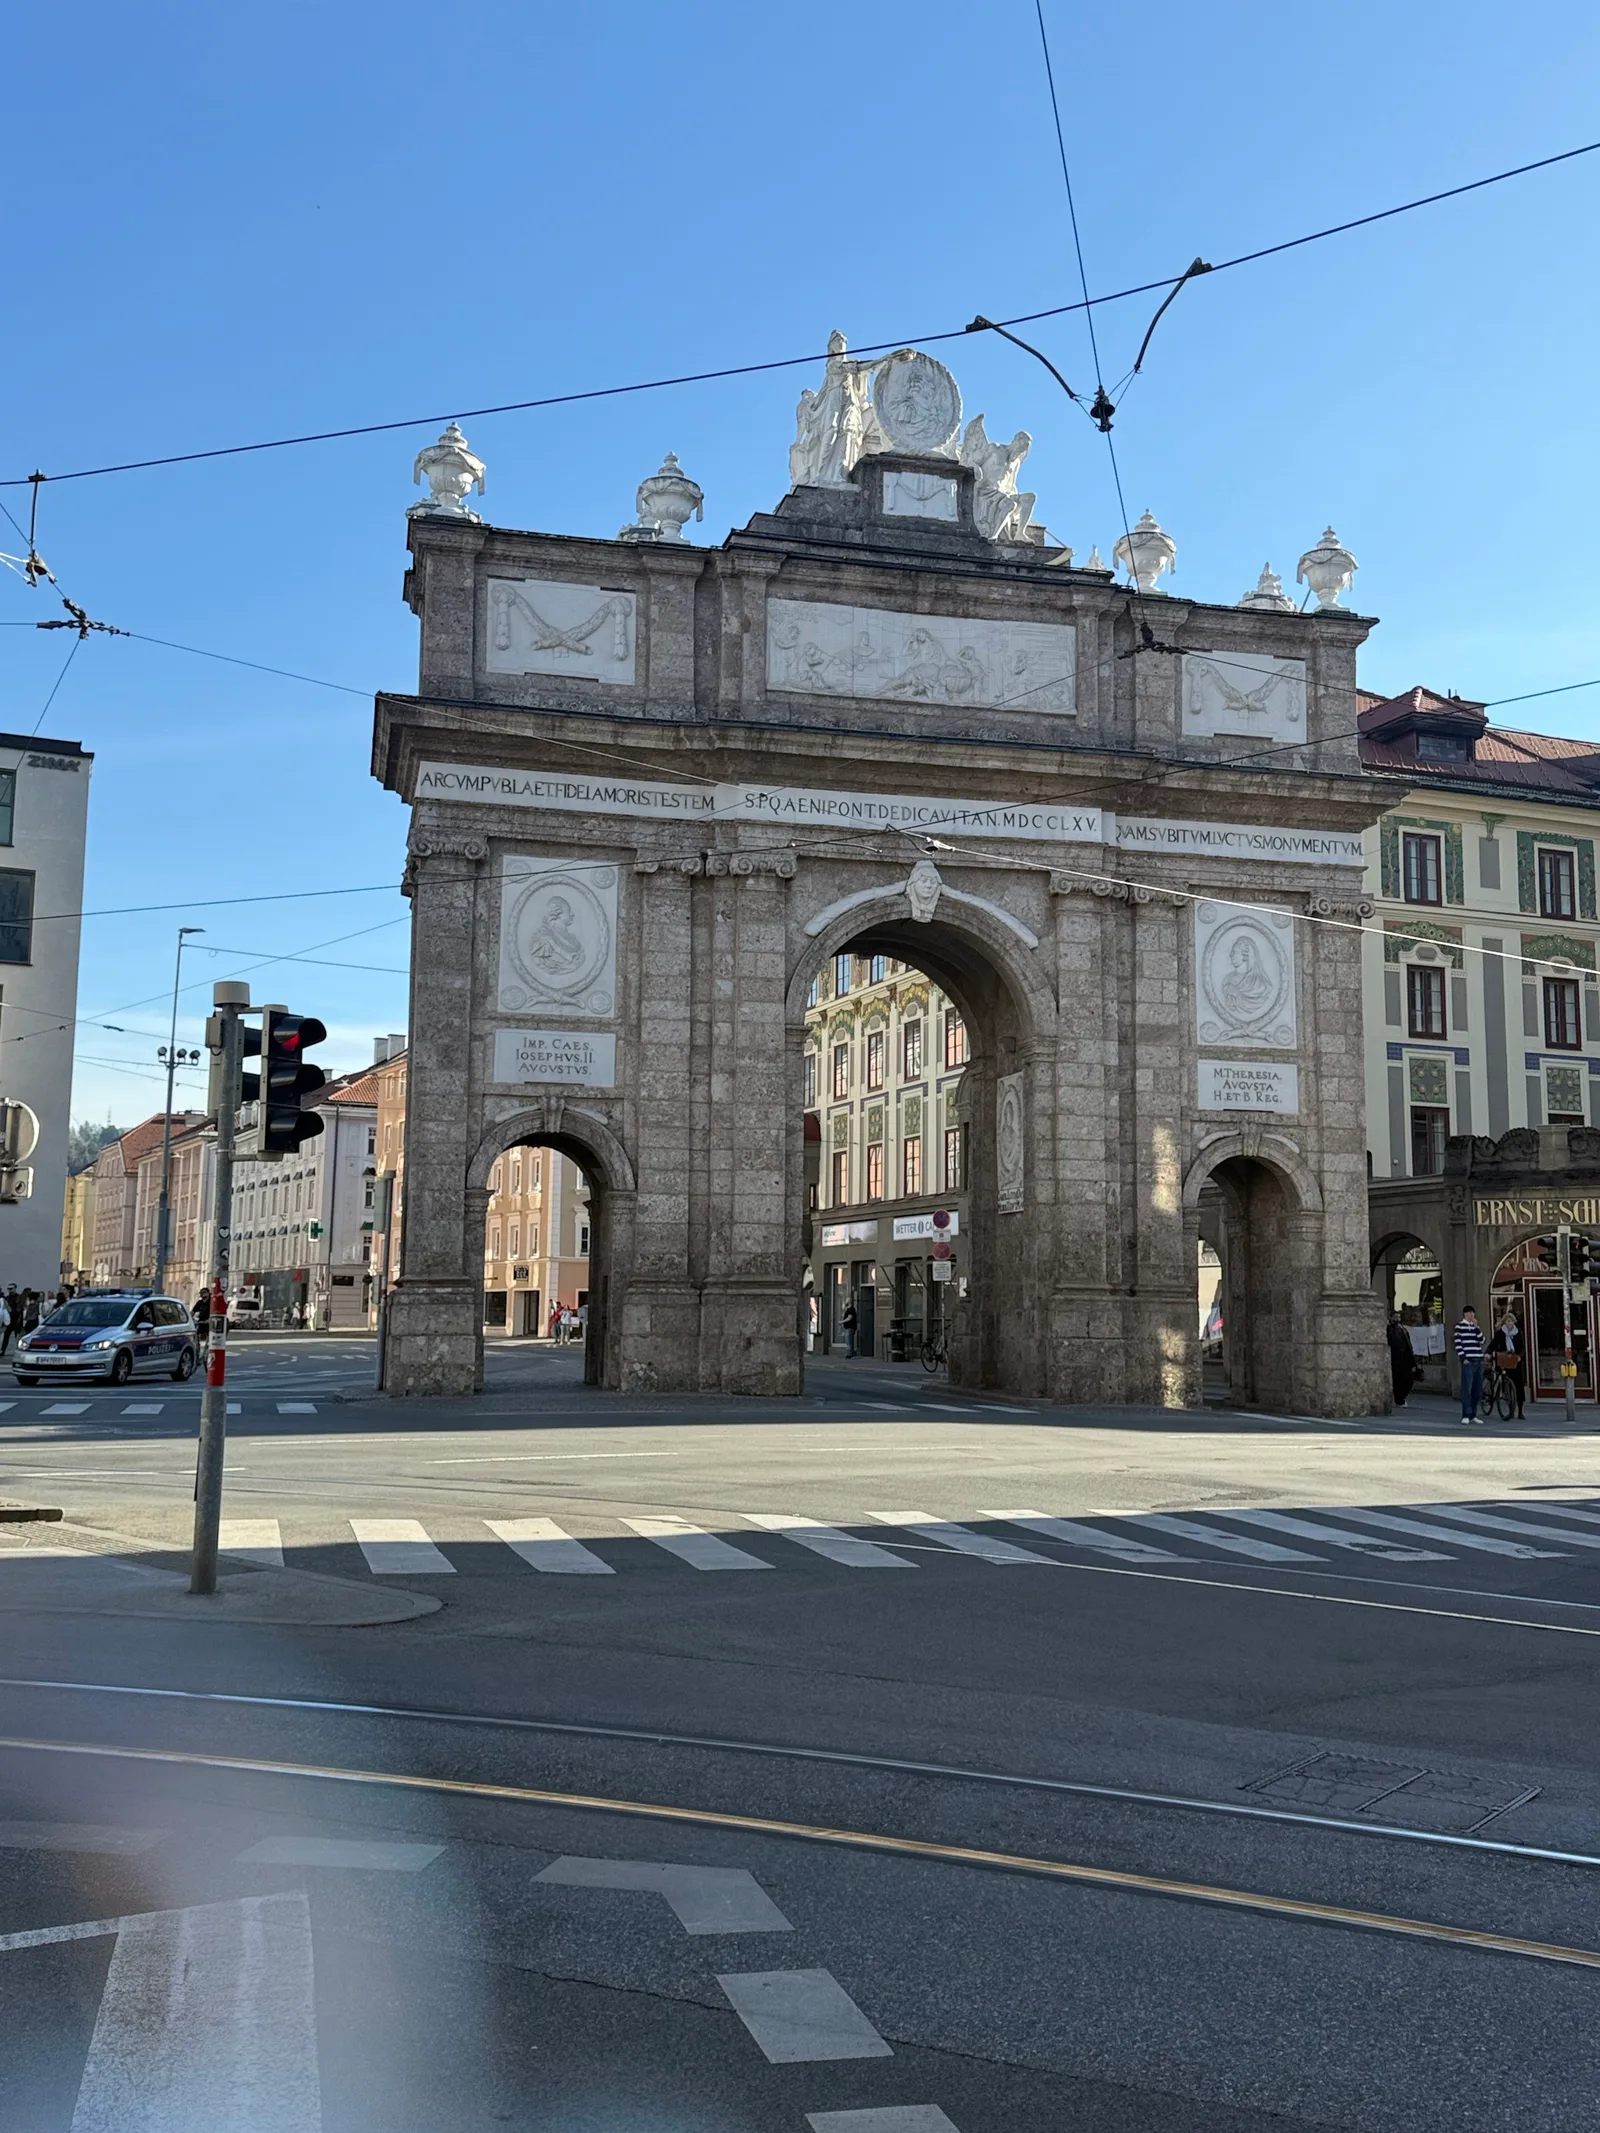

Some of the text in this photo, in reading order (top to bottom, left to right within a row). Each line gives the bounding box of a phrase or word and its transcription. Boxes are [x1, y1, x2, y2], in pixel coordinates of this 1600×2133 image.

[523, 1037, 594, 1051] IMP. CAES.
[518, 1062, 592, 1075] AVGVSTVS.
[1223, 1080, 1278, 1092] AVGVSTA.
[1475, 1199, 1600, 1225] ERNST SCH
[895, 1223, 917, 1235] WETTER
[148, 1343, 171, 1356] POLIZEI
